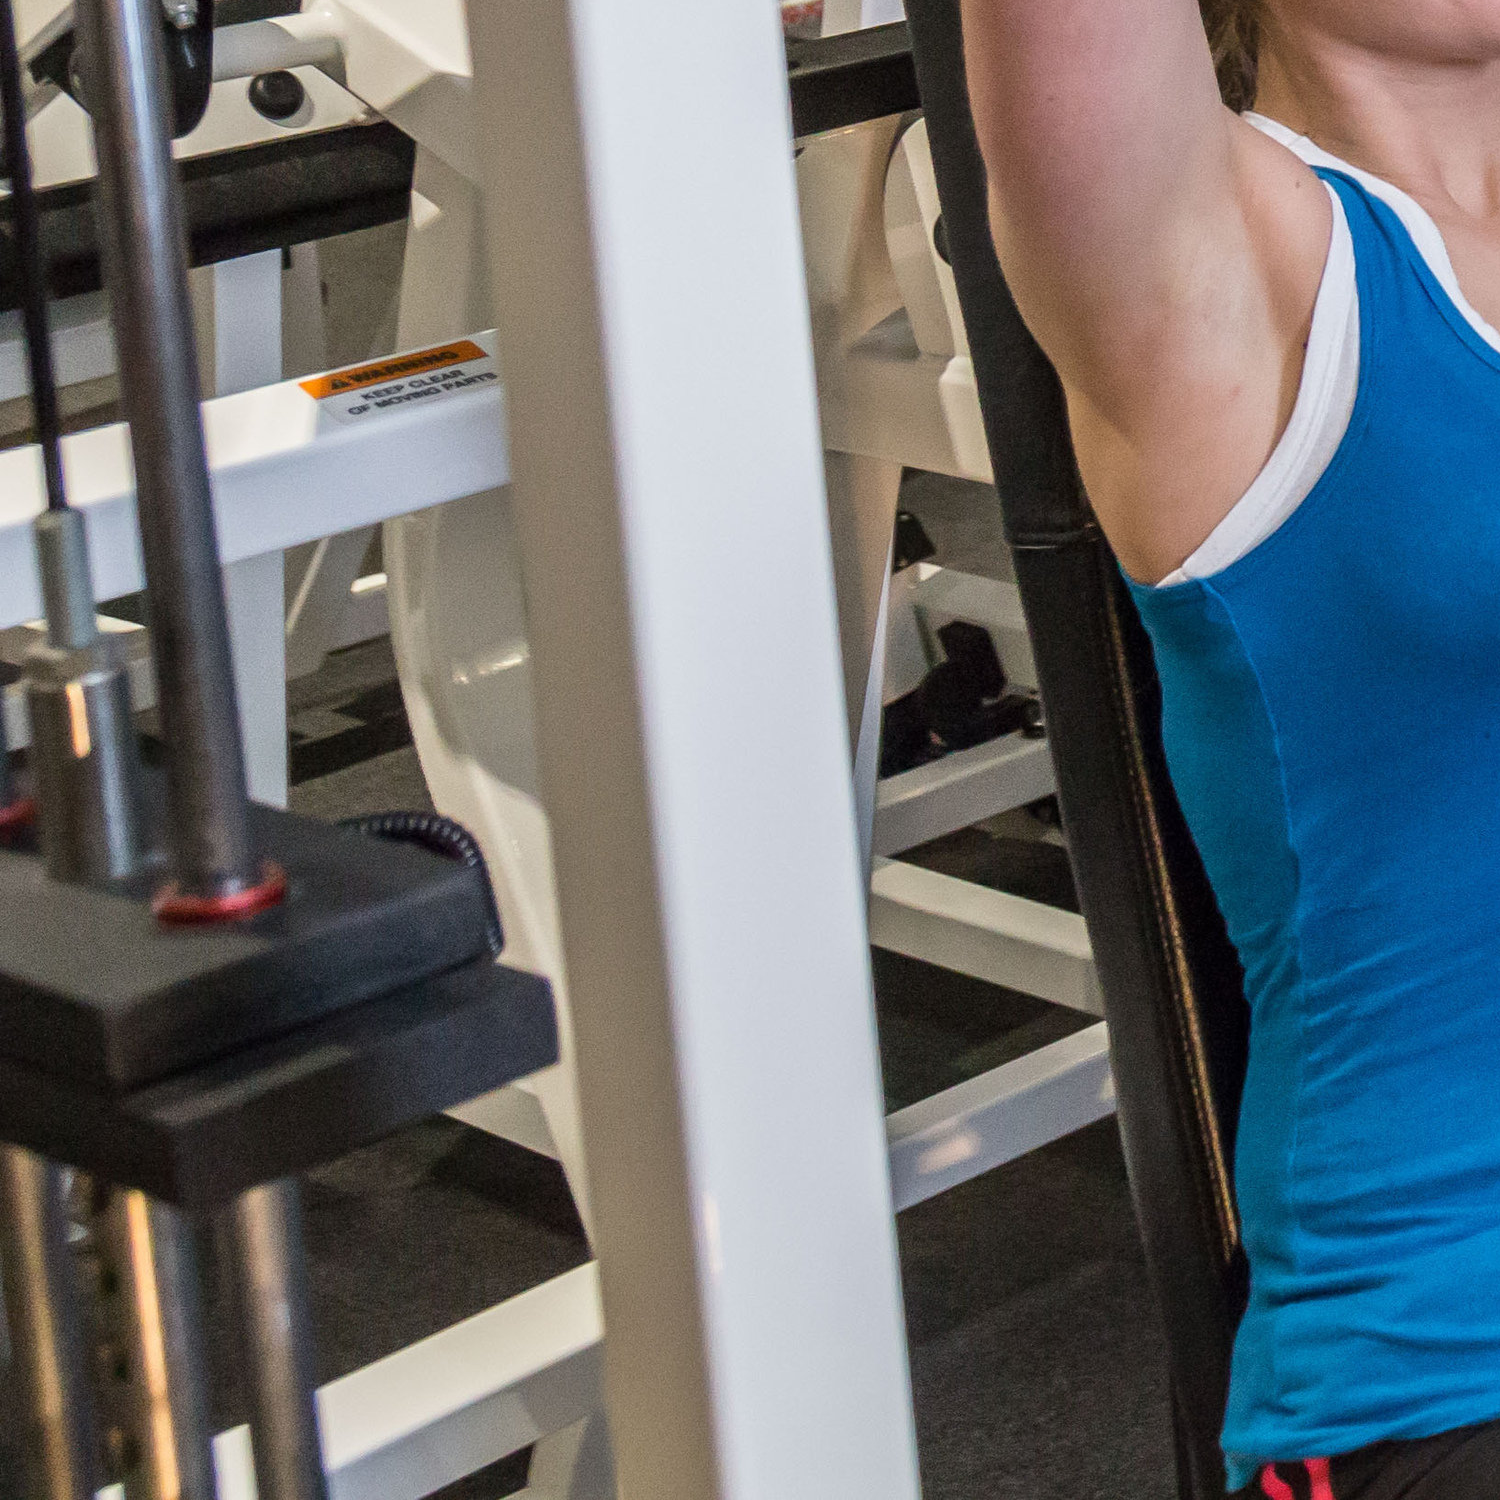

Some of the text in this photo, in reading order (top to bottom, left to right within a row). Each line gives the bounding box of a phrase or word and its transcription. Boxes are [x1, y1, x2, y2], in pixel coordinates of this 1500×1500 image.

[360, 369, 465, 401] KEEP CLEAR
[374, 386, 441, 409] MOVING
[443, 371, 498, 391] PARTS
